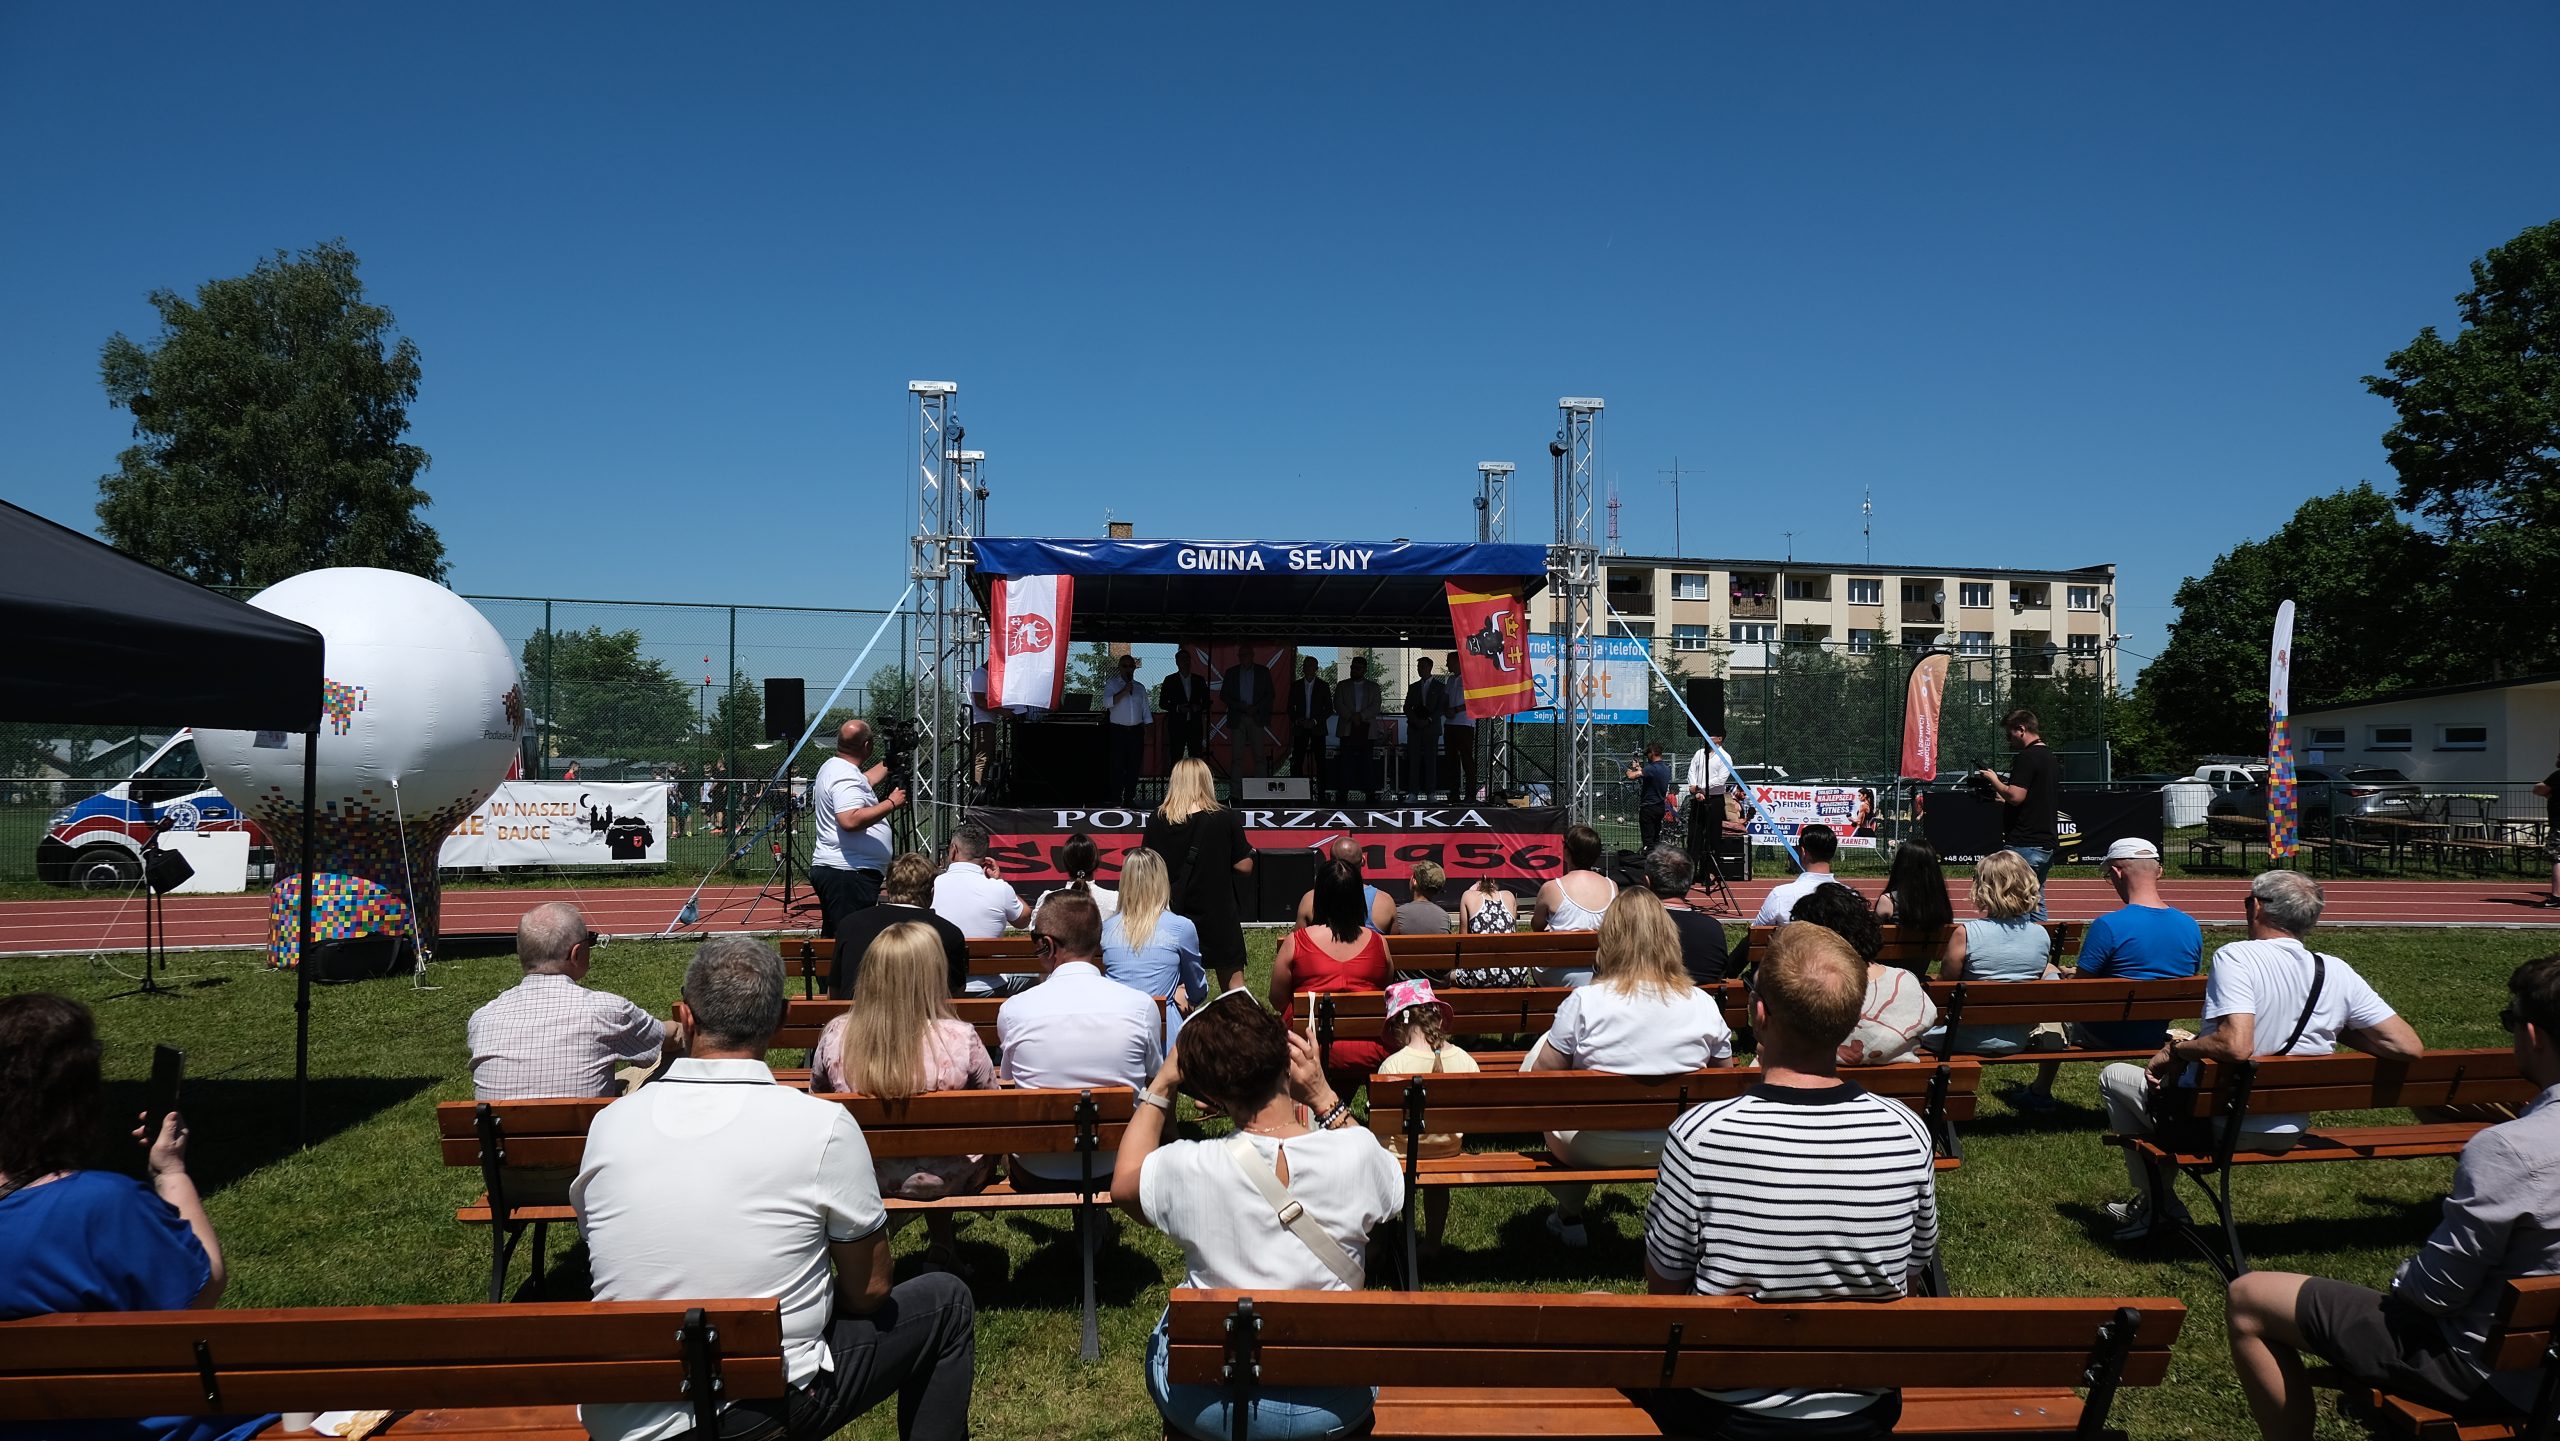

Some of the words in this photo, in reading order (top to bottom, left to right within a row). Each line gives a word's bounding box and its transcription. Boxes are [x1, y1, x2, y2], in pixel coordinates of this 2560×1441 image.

[1177, 549, 1265, 571] GMINA
[1288, 550, 1373, 570] SEJNY
[1613, 712, 1618, 720] 8
[1757, 787, 1811, 803] XTREME
[491, 803, 509, 816] W
[515, 803, 577, 816] NASZEJ
[1821, 806, 1850, 814] FITNESS
[450, 815, 485, 836] IE
[1053, 809, 1492, 829] PORZANKA
[497, 826, 550, 840] BAJCE
[1361, 843, 1561, 870] 1956
